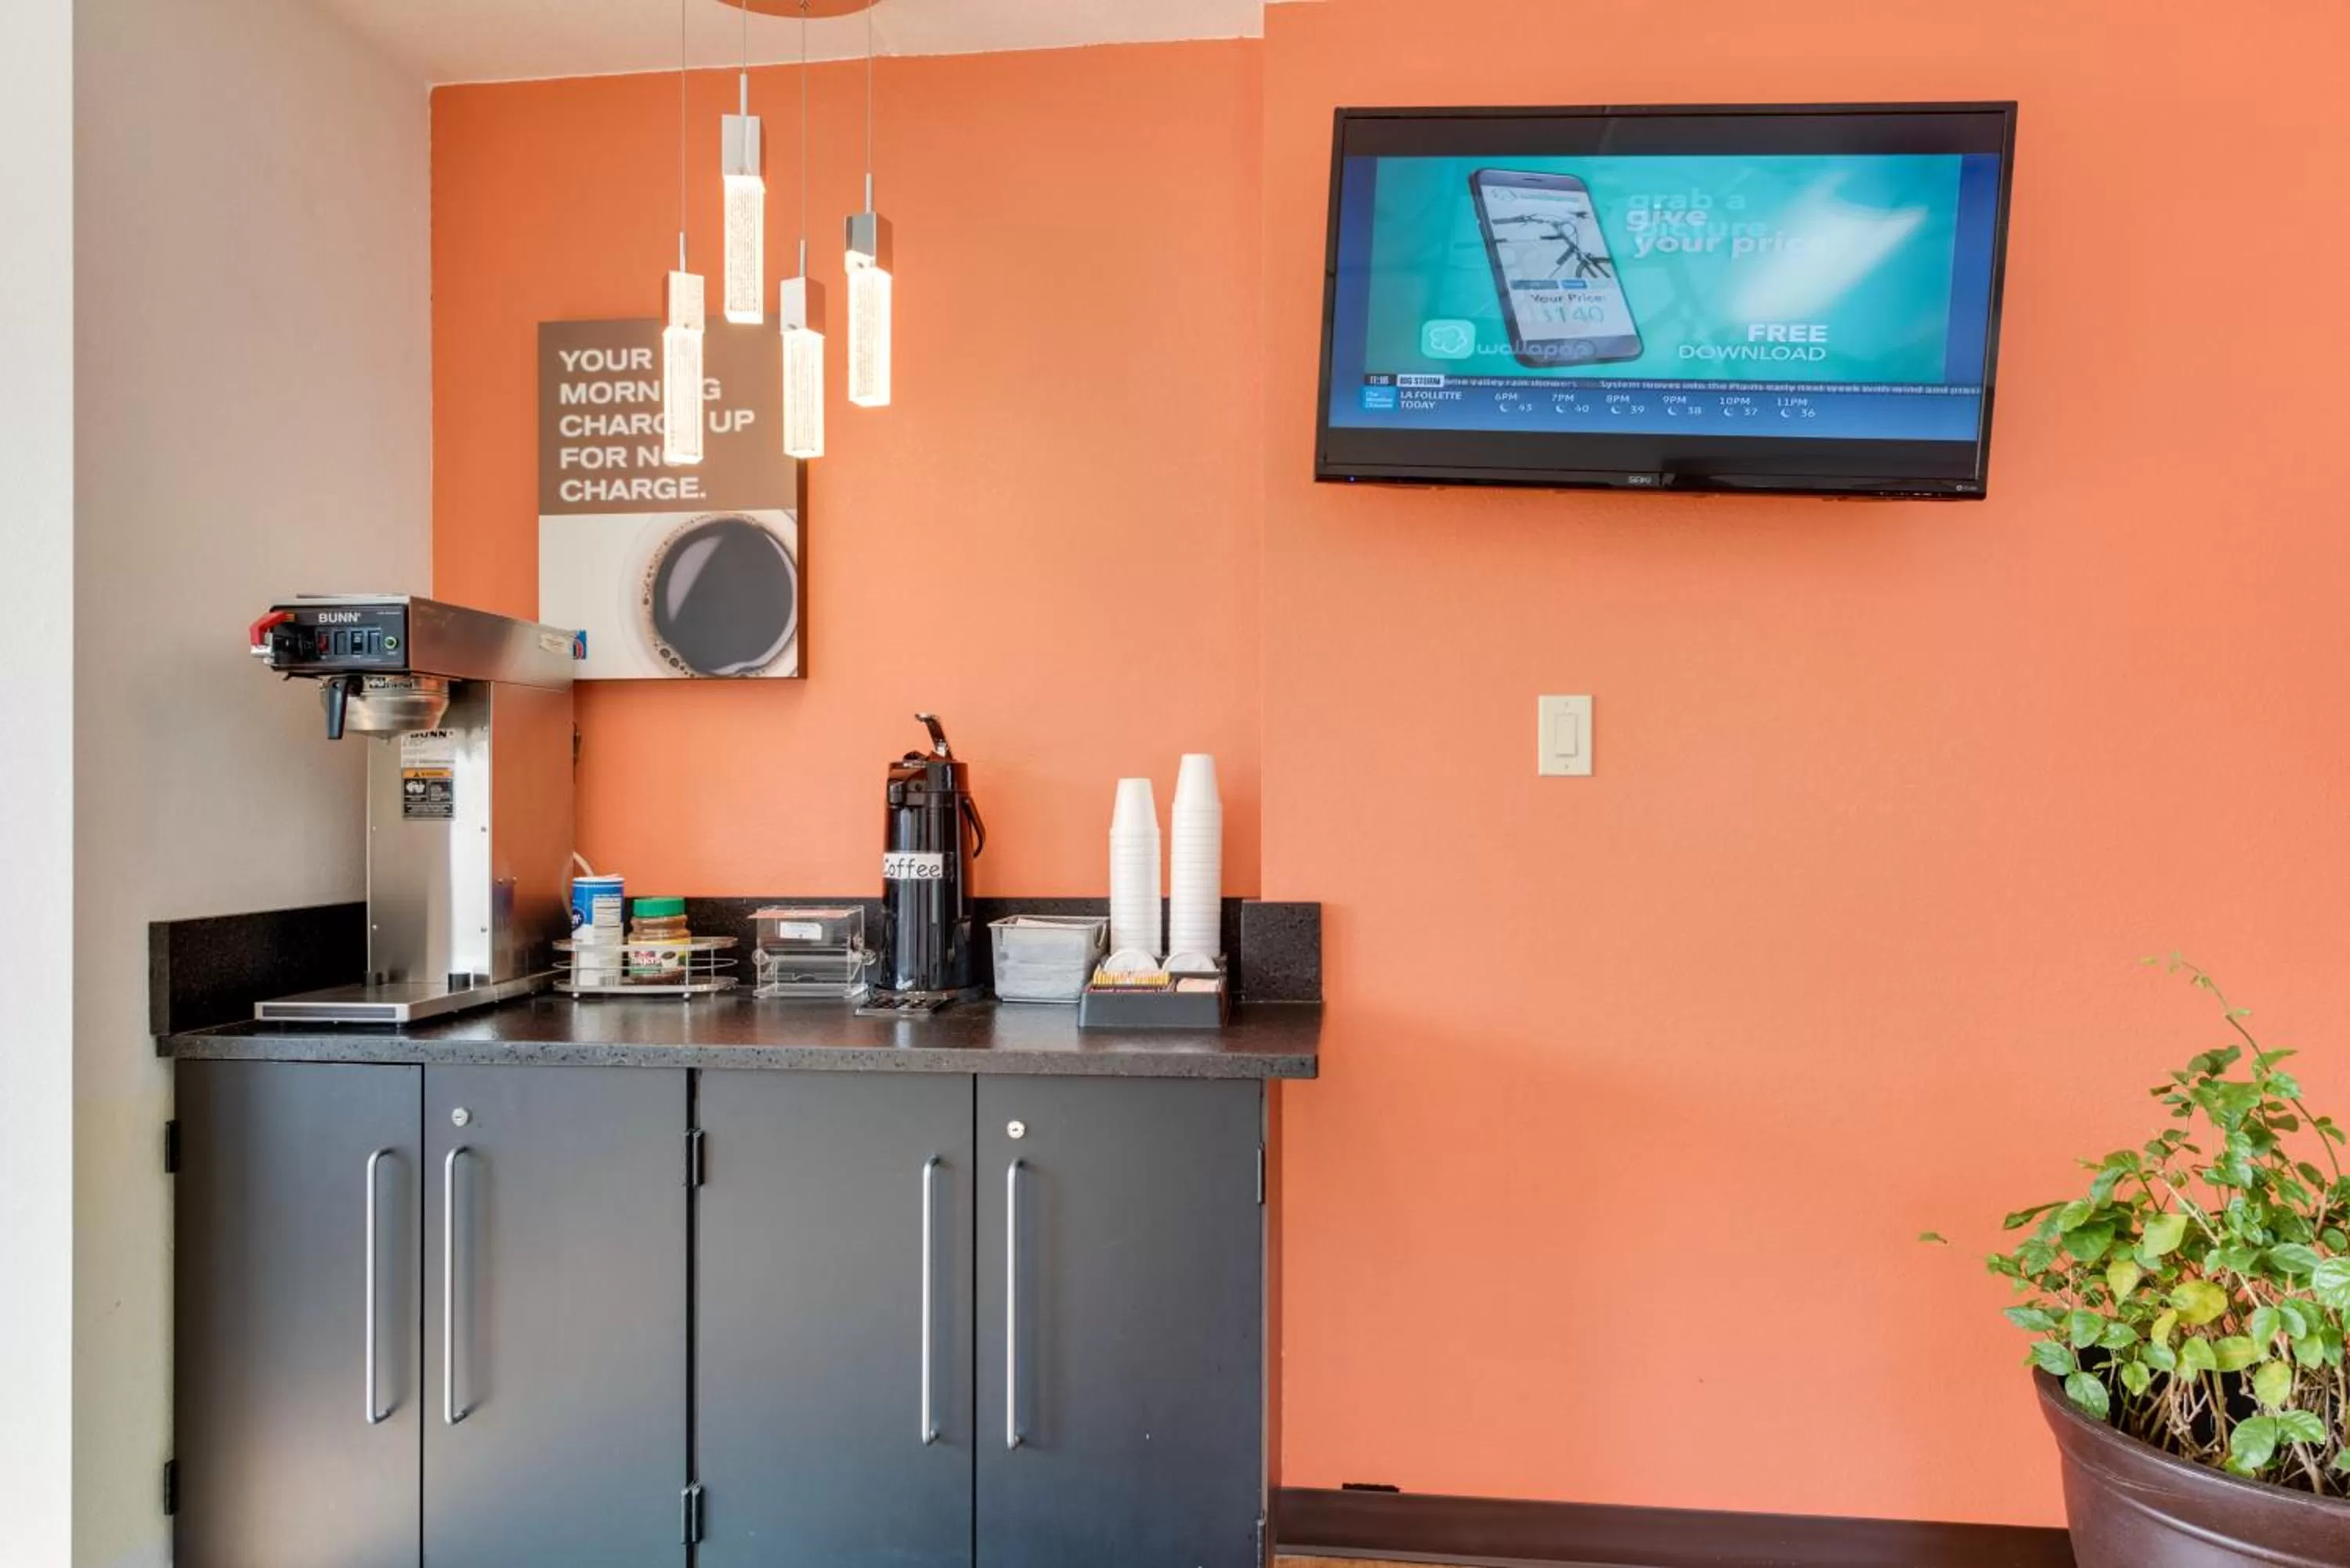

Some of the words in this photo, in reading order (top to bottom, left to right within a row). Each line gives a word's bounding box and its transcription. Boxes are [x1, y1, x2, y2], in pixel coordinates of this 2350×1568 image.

[1626, 204, 1708, 231] give
[1634, 236, 1721, 258] your
[1732, 232, 1826, 258] pric
[1531, 294, 1562, 304] Your
[1748, 324, 1829, 342] FREE
[559, 348, 653, 372] YOUR
[1679, 345, 1826, 361] DOWNLOAD
[559, 378, 721, 405] MORNG
[1415, 392, 1462, 400] FOLLETTE
[1495, 392, 1518, 401] 6PM
[1552, 393, 1574, 402] 7PM
[1606, 395, 1630, 403] 8PM
[1663, 396, 1687, 404] 9PM
[1719, 396, 1751, 406] 10PM
[1777, 397, 1808, 406] 11PM
[1400, 400, 1436, 409] TODAY
[1630, 405, 1644, 414] 39
[1687, 406, 1702, 415] 38
[1744, 407, 1758, 416] 37
[1801, 409, 1816, 417] 36
[559, 412, 696, 437] CHAR
[709, 410, 755, 432] UP
[559, 446, 627, 469] FOR
[559, 477, 707, 501] CHARGE.
[318, 612, 358, 623] BUNN
